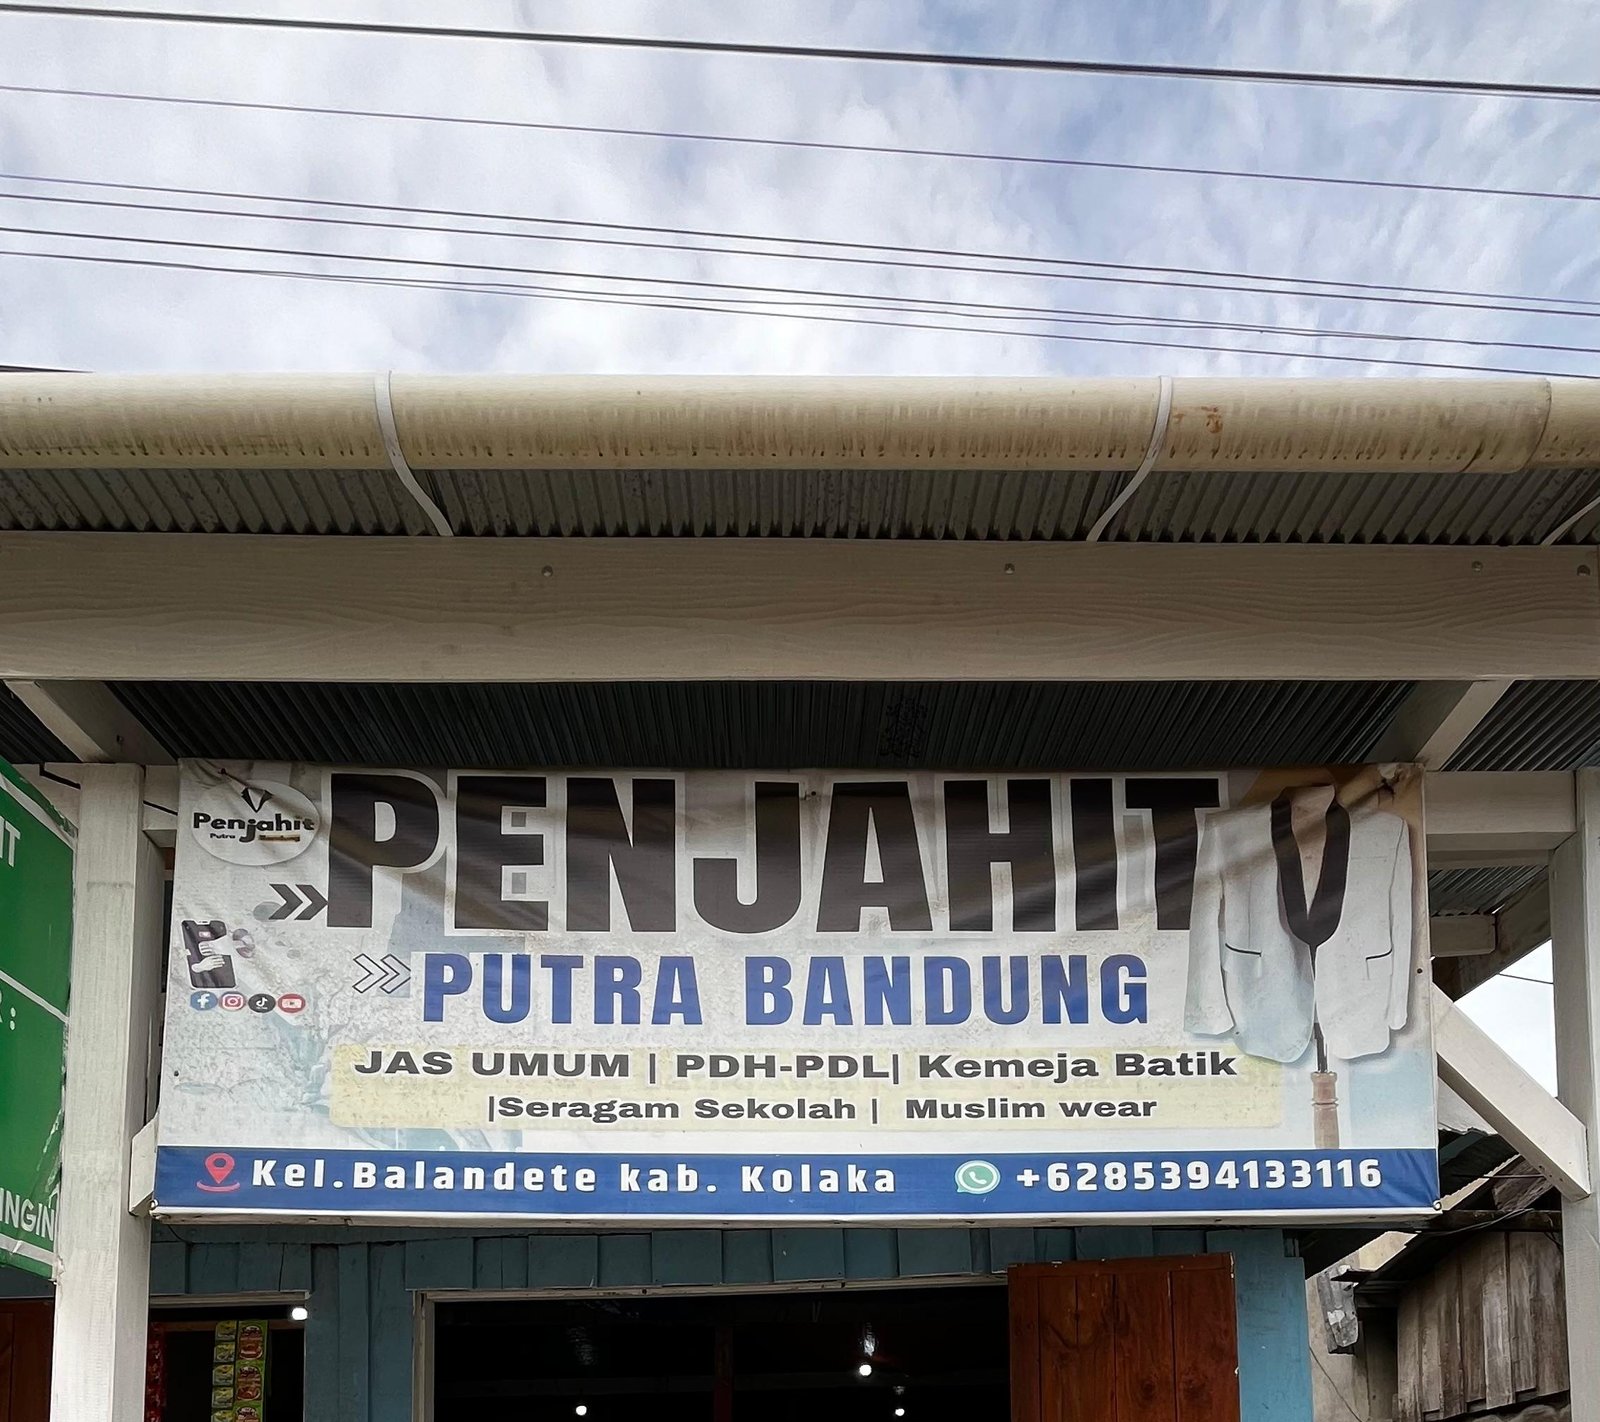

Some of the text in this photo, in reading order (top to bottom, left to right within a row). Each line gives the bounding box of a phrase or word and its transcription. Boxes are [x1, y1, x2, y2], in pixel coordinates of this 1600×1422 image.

[193, 812, 315, 843] Penjahit
[327, 773, 1221, 935] PENJAHIT
[422, 953, 1149, 1026] PUTRA BANDUNG
[354, 1050, 453, 1075] JAS
[472, 1052, 630, 1078] UMUM
[919, 1052, 1099, 1084] Kemeja
[1115, 1051, 1238, 1077] Batik
[694, 1097, 856, 1119] Sekolah
[905, 1097, 1046, 1119] Muslim
[1058, 1100, 1158, 1118] wear
[252, 1159, 896, 1193] Kel.Balandete kab. Kolaka
[1016, 1158, 1382, 1192] +6285394133116
